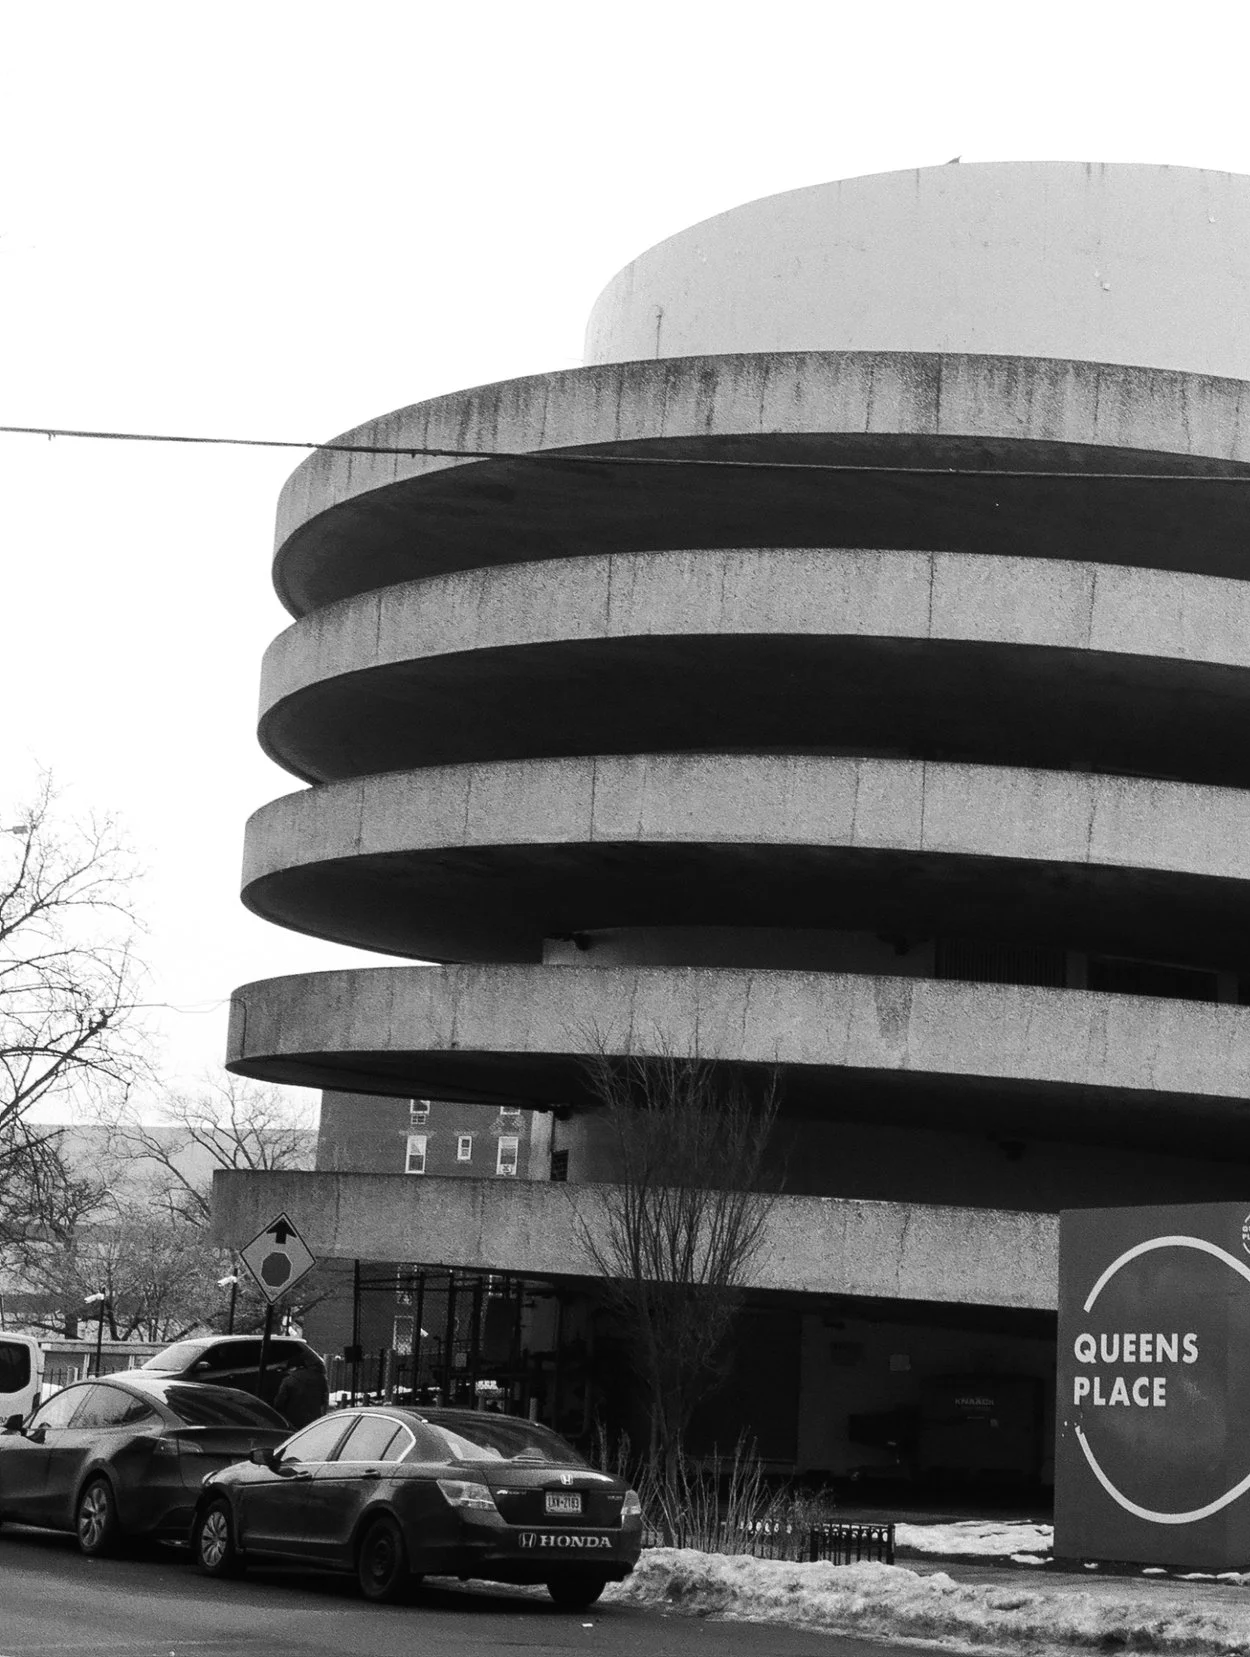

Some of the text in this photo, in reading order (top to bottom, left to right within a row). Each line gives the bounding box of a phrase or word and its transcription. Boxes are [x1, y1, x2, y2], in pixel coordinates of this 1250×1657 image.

[1073, 1333, 1199, 1364] QUEENS
[1073, 1377, 1167, 1407] PLACE
[540, 1535, 612, 1548] HONDA
